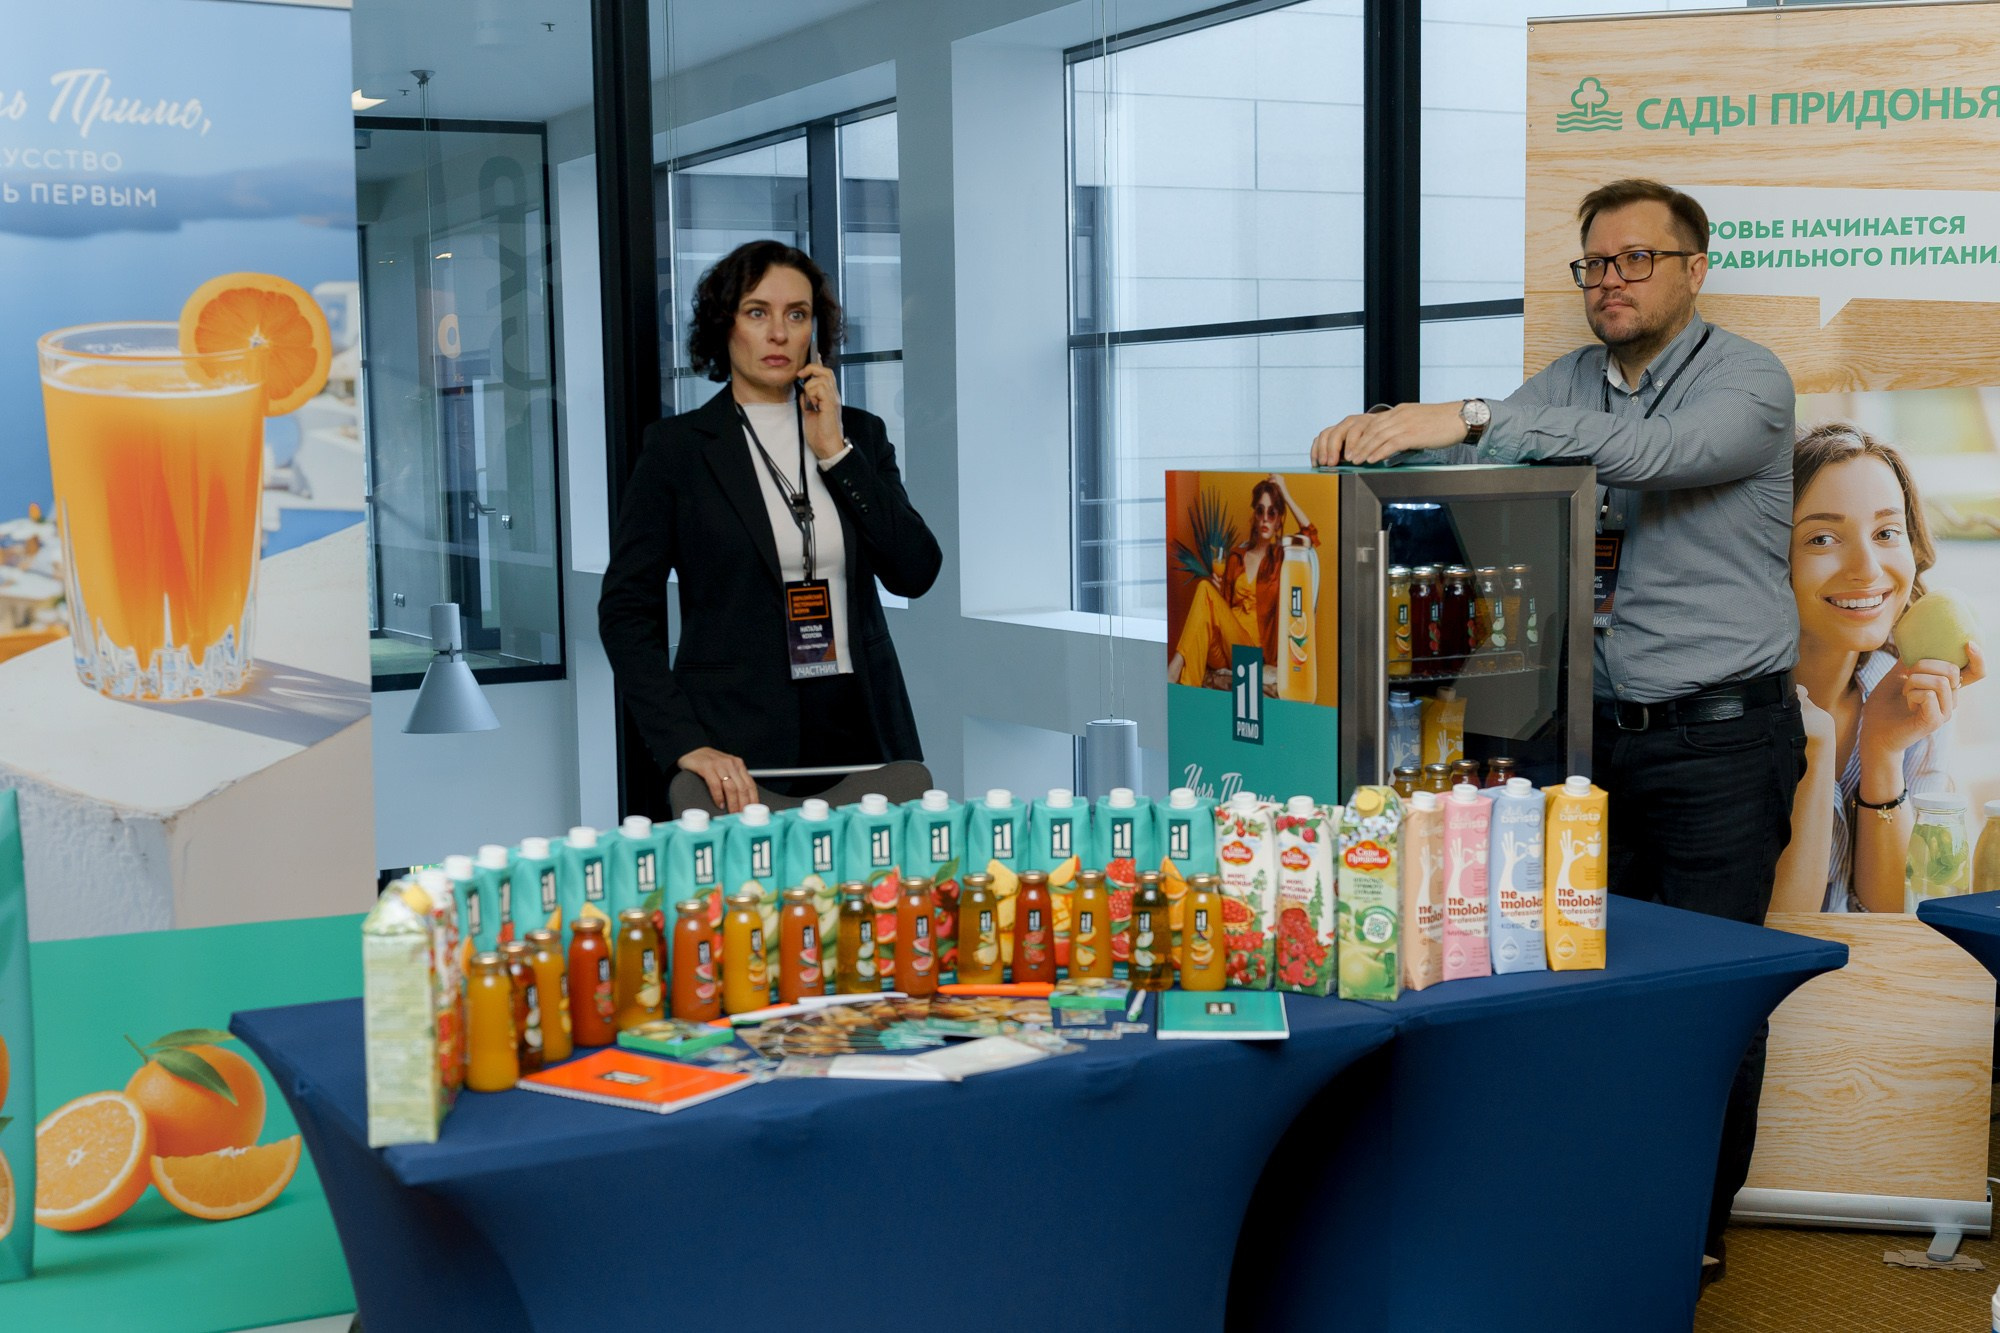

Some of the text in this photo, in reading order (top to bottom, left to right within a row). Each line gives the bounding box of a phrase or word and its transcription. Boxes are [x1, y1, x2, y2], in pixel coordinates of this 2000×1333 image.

[50, 67, 213, 139] Примо,
[1636, 85, 2000, 136] САДЫ ПРИДОНЬЯ
[31, 181, 158, 209] ПЕРВЫМ
[1792, 215, 1966, 238] НАЧИНАЕТСЯ
[1891, 245, 2000, 267] ПИТАНИ
[794, 663, 837, 677] УЧАСТНИК
[1236, 661, 1259, 721] il
[1236, 720, 1259, 740] PRIMO
[1448, 897, 1465, 906] ne
[1500, 890, 1518, 900] ne
[1557, 888, 1575, 897] ne
